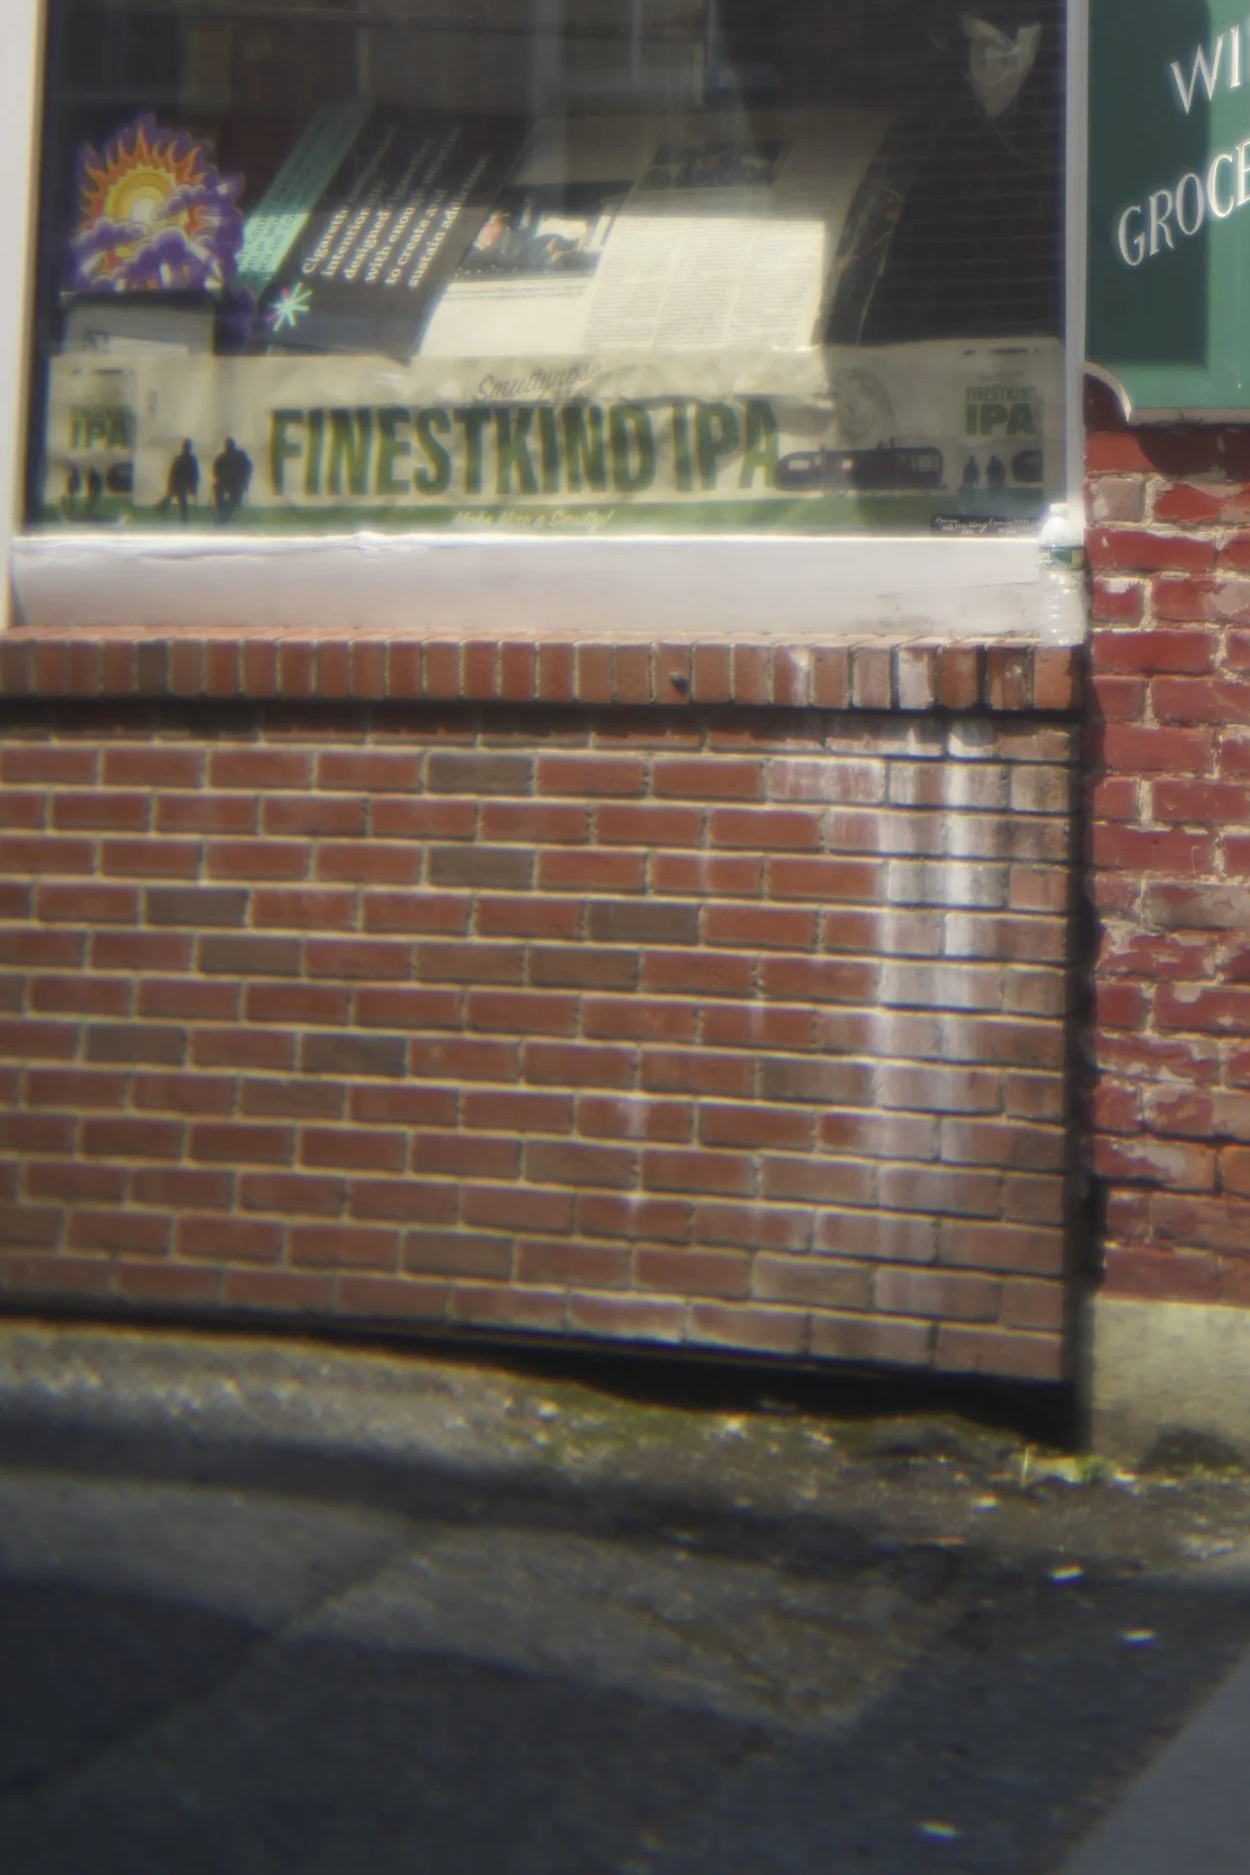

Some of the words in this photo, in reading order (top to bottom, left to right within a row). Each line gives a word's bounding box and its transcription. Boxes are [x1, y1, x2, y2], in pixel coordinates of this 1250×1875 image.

[343, 209, 392, 280] designed
[365, 244, 393, 283] with
[384, 267, 402, 285] to
[398, 219, 432, 265] create
[425, 189, 448, 217] and
[408, 231, 447, 288] sustain
[269, 405, 656, 494] FINESTKIND
[671, 399, 778, 493] IPA
[965, 403, 1036, 436] IPA
